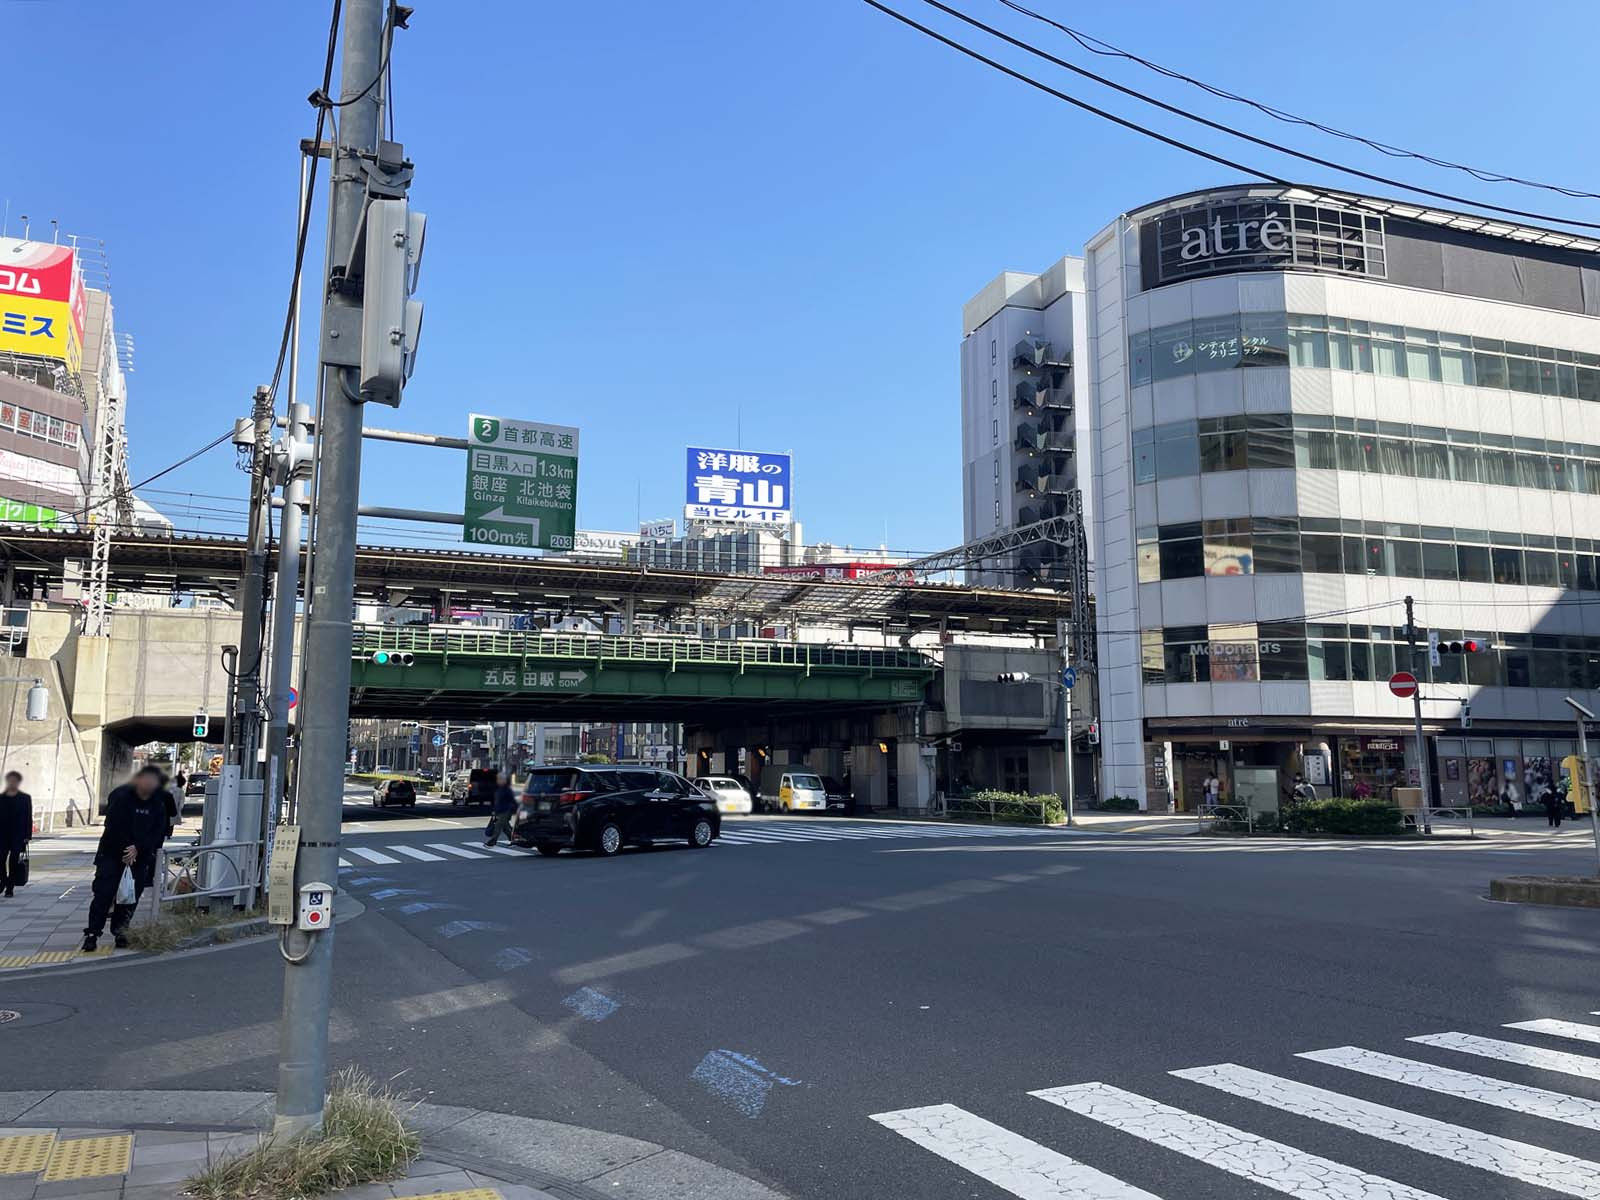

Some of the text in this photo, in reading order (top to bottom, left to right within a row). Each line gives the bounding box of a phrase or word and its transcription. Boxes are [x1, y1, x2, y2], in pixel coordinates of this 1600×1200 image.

[1180, 212, 1288, 260] atré
[481, 422, 492, 437] 2
[503, 426, 574, 450] 首都高速
[476, 453, 574, 480] 目黒入口 1.3km
[697, 452, 782, 475] 洋服の
[472, 473, 572, 500] 銀座 北池袋
[694, 475, 783, 508] 青山
[473, 490, 573, 510] Ginza Kitaikebukuro
[469, 527, 529, 545] 100m先
[551, 536, 572, 548] 203
[484, 670, 555, 687] 五反田駅
